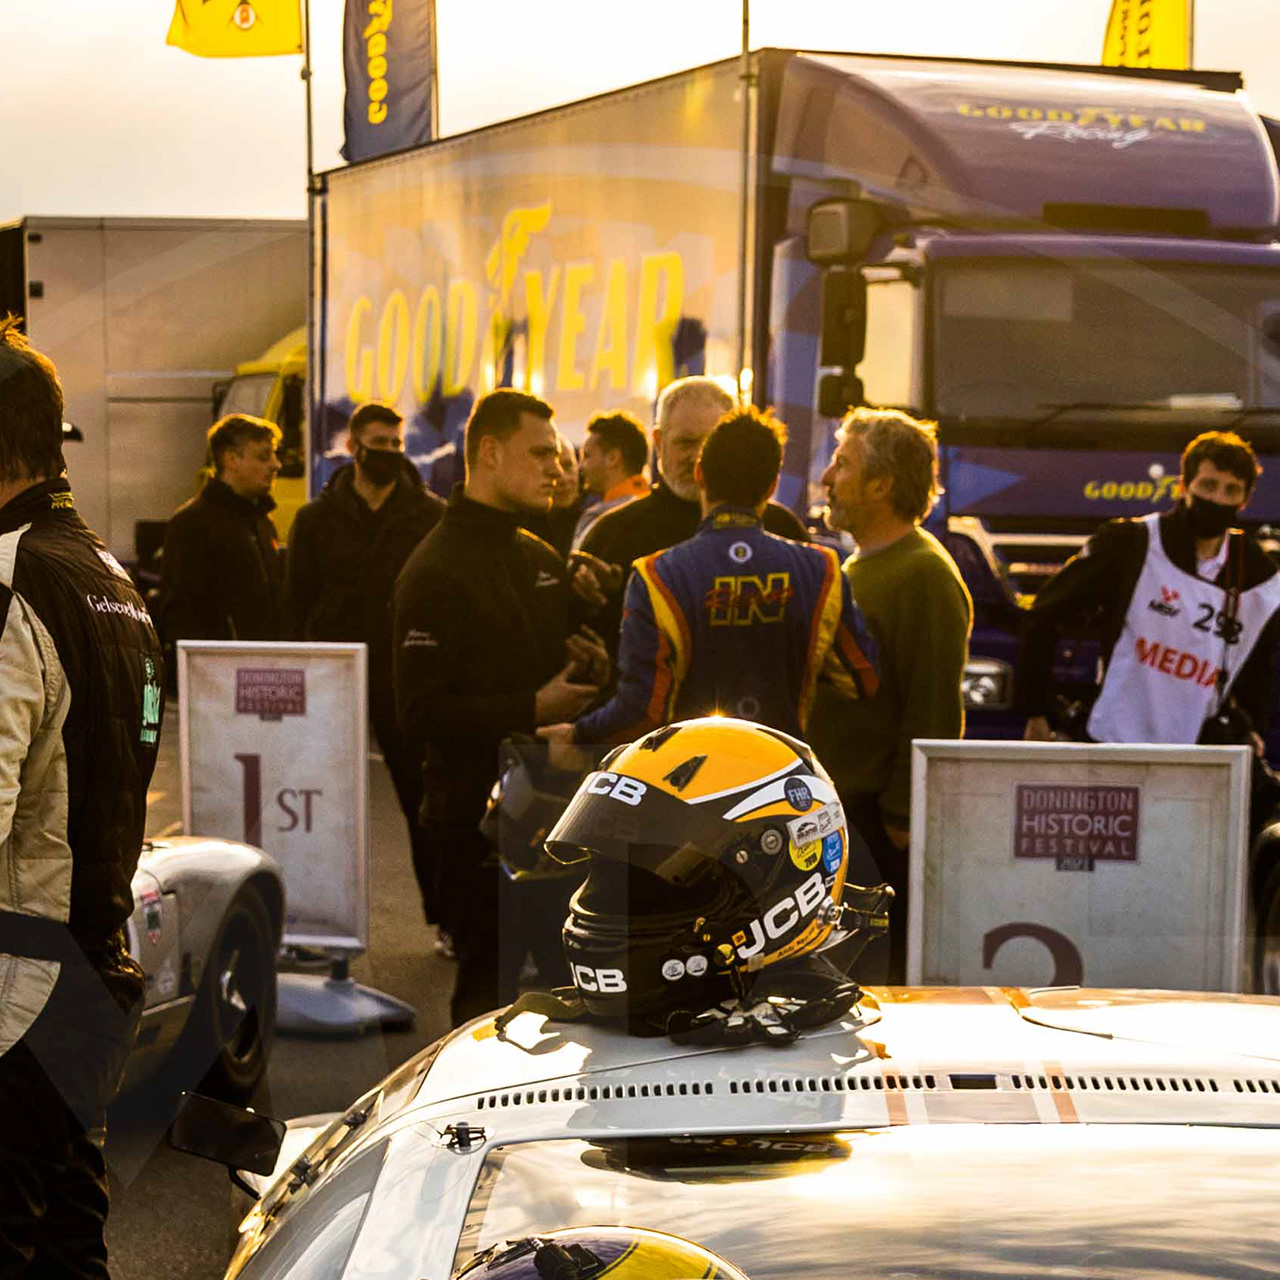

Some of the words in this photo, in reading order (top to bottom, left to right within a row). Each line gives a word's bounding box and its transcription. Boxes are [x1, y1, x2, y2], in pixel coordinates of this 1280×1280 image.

[345, 252, 684, 404] GOODYEAR
[1133, 636, 1220, 687] MEDIA
[587, 772, 648, 806] CB
[787, 786, 810, 803] FHR
[1023, 790, 1134, 811] DONINGTON
[1022, 814, 1132, 837] HISTORIC
[1022, 838, 1131, 855] FESTIVAL
[736, 872, 826, 959] JCB
[570, 961, 628, 993] CB
